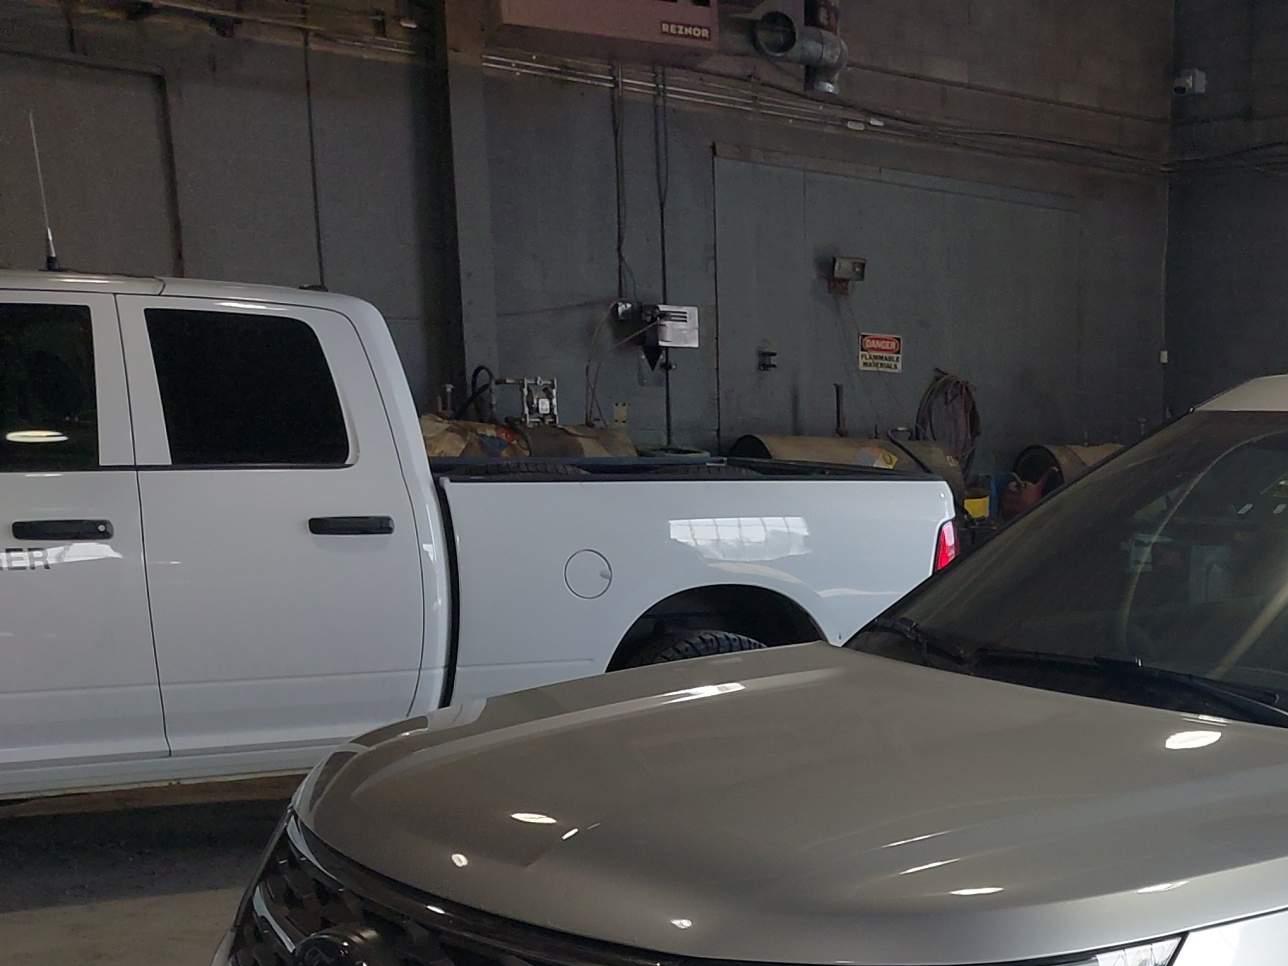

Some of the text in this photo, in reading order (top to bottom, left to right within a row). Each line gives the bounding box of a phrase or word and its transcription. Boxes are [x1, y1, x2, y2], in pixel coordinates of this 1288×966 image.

[661, 23, 709, 38] REZNOR
[864, 339, 897, 350] DANGER
[860, 353, 900, 363] FLAMMABLE
